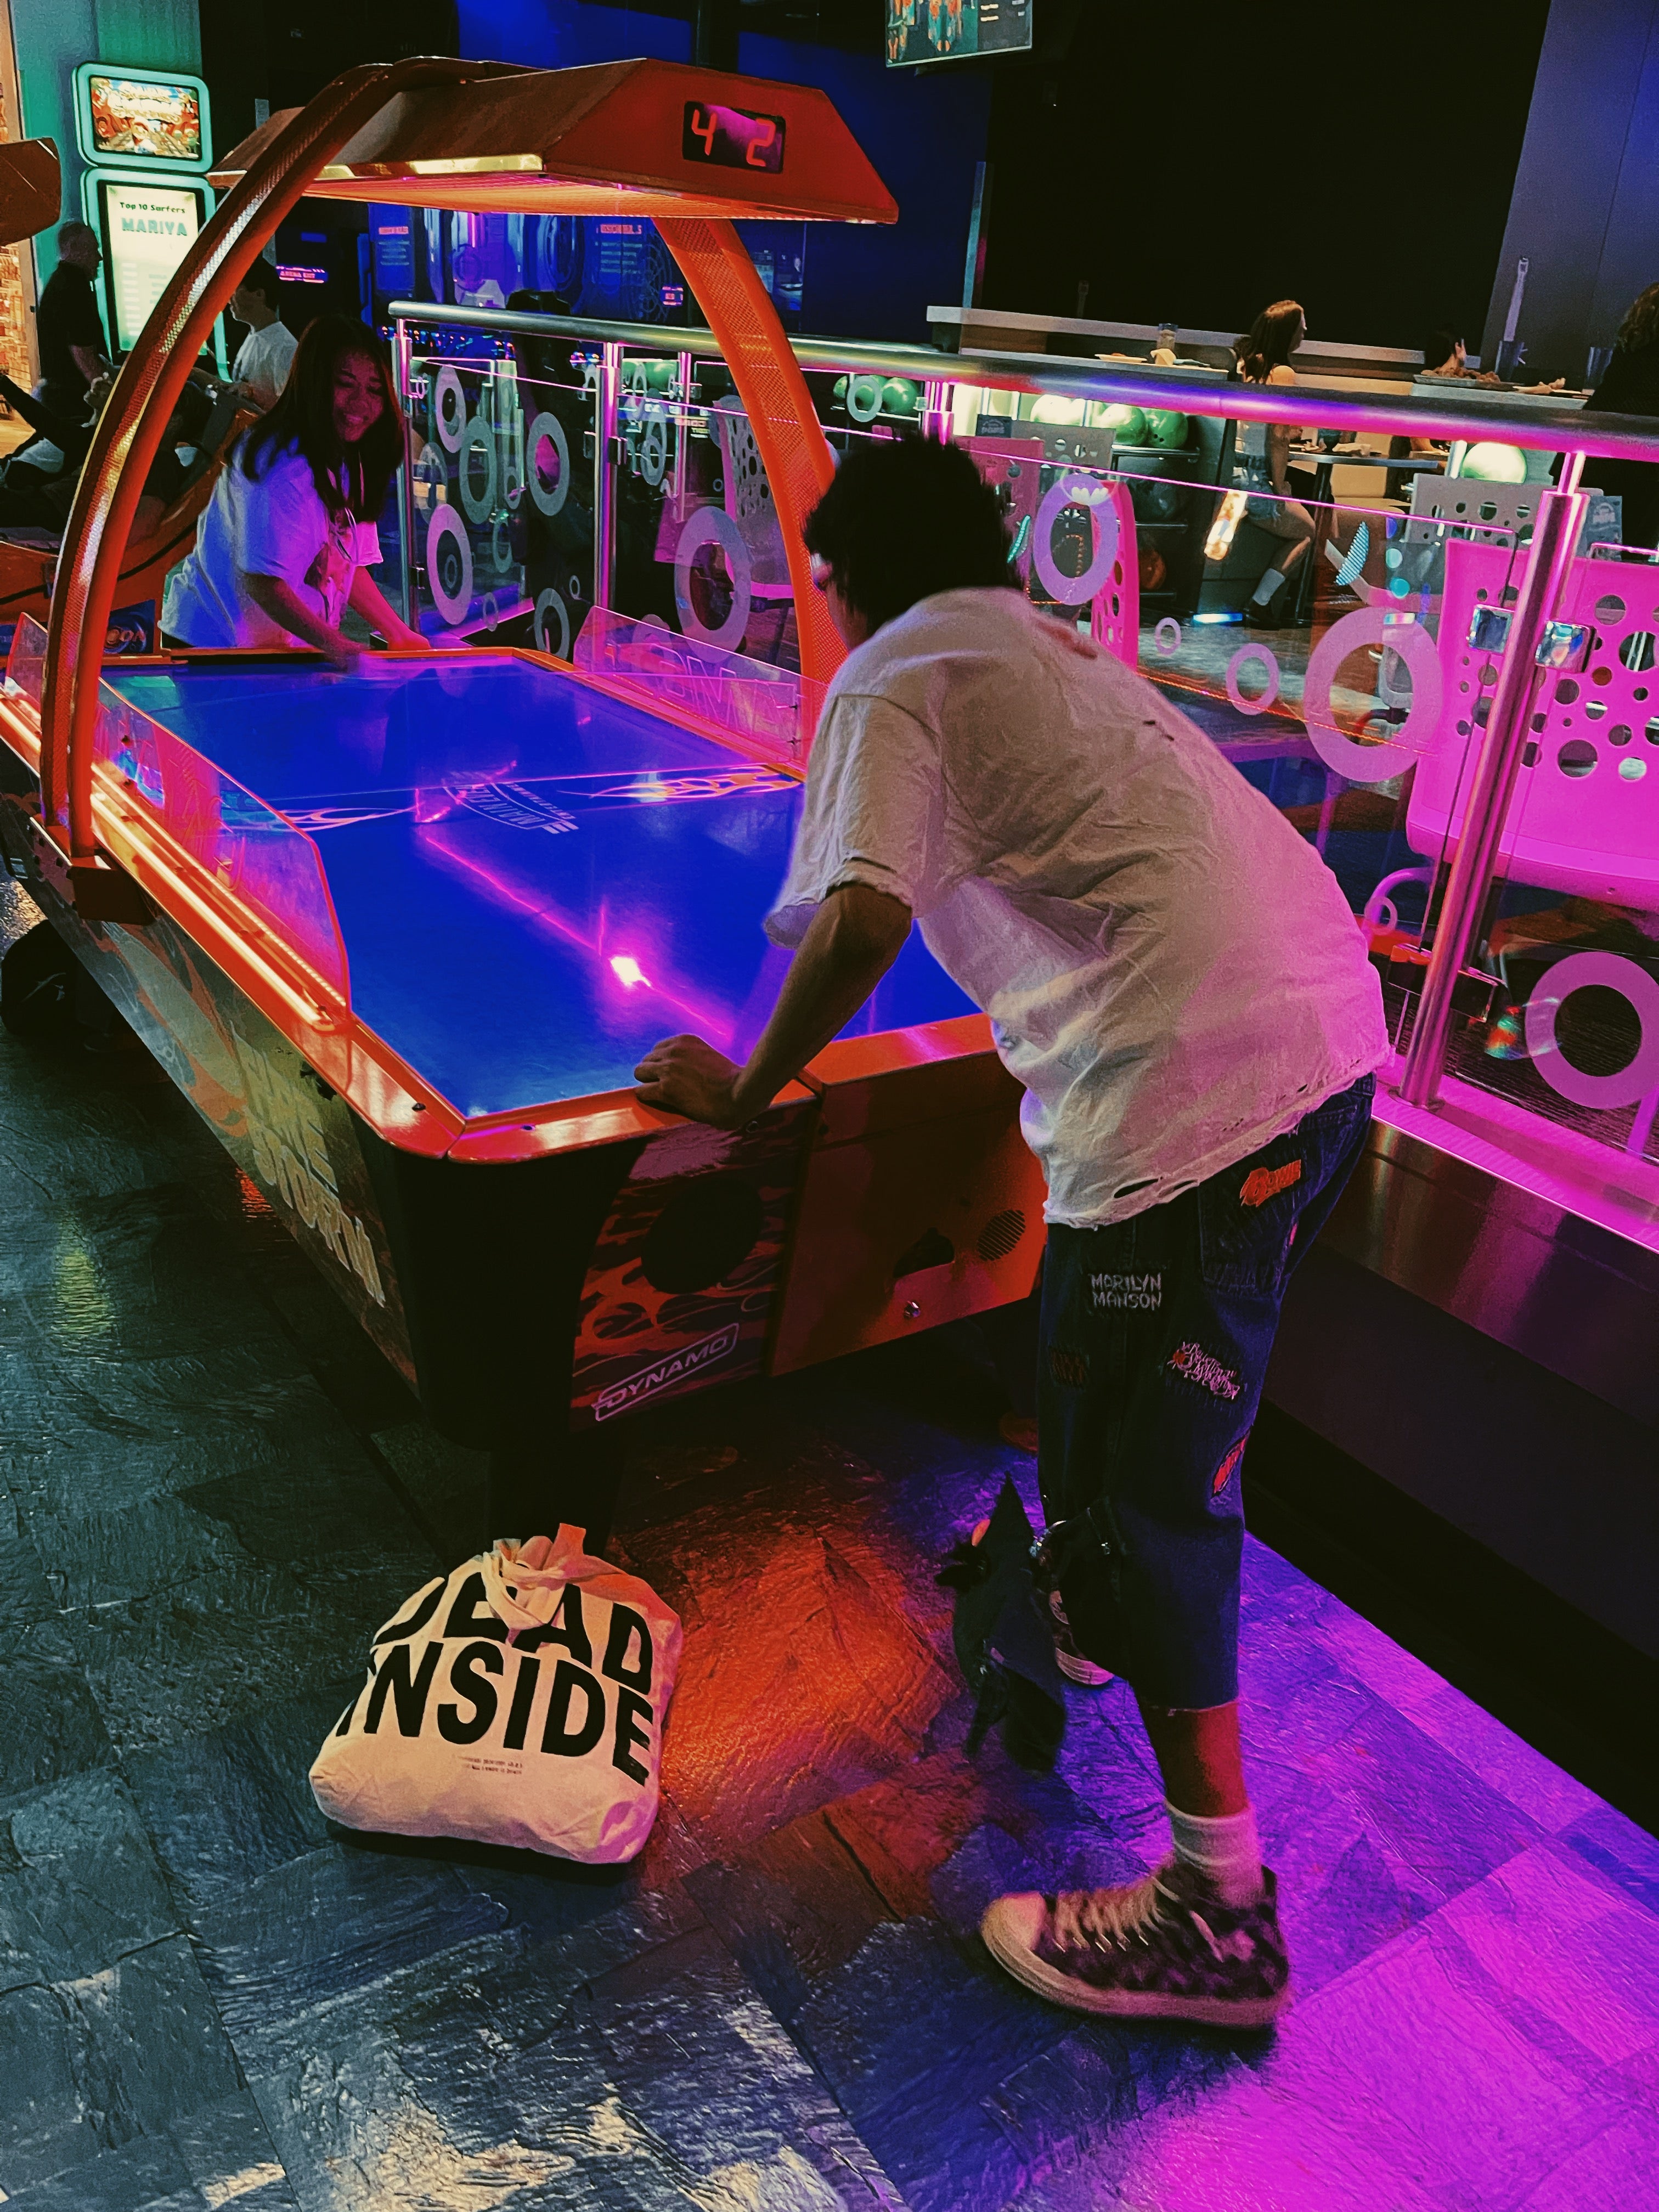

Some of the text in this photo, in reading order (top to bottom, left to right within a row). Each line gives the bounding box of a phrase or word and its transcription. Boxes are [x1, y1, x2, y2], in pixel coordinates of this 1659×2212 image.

[691, 109, 776, 167] 4 2
[120, 202, 136, 210] Top
[151, 205, 185, 213] Surfers
[122, 217, 188, 236] MARIYA
[247, 1109, 385, 1307] STORM
[1093, 1291, 1161, 1311] MANSON
[600, 1336, 728, 1408] DYNAMO
